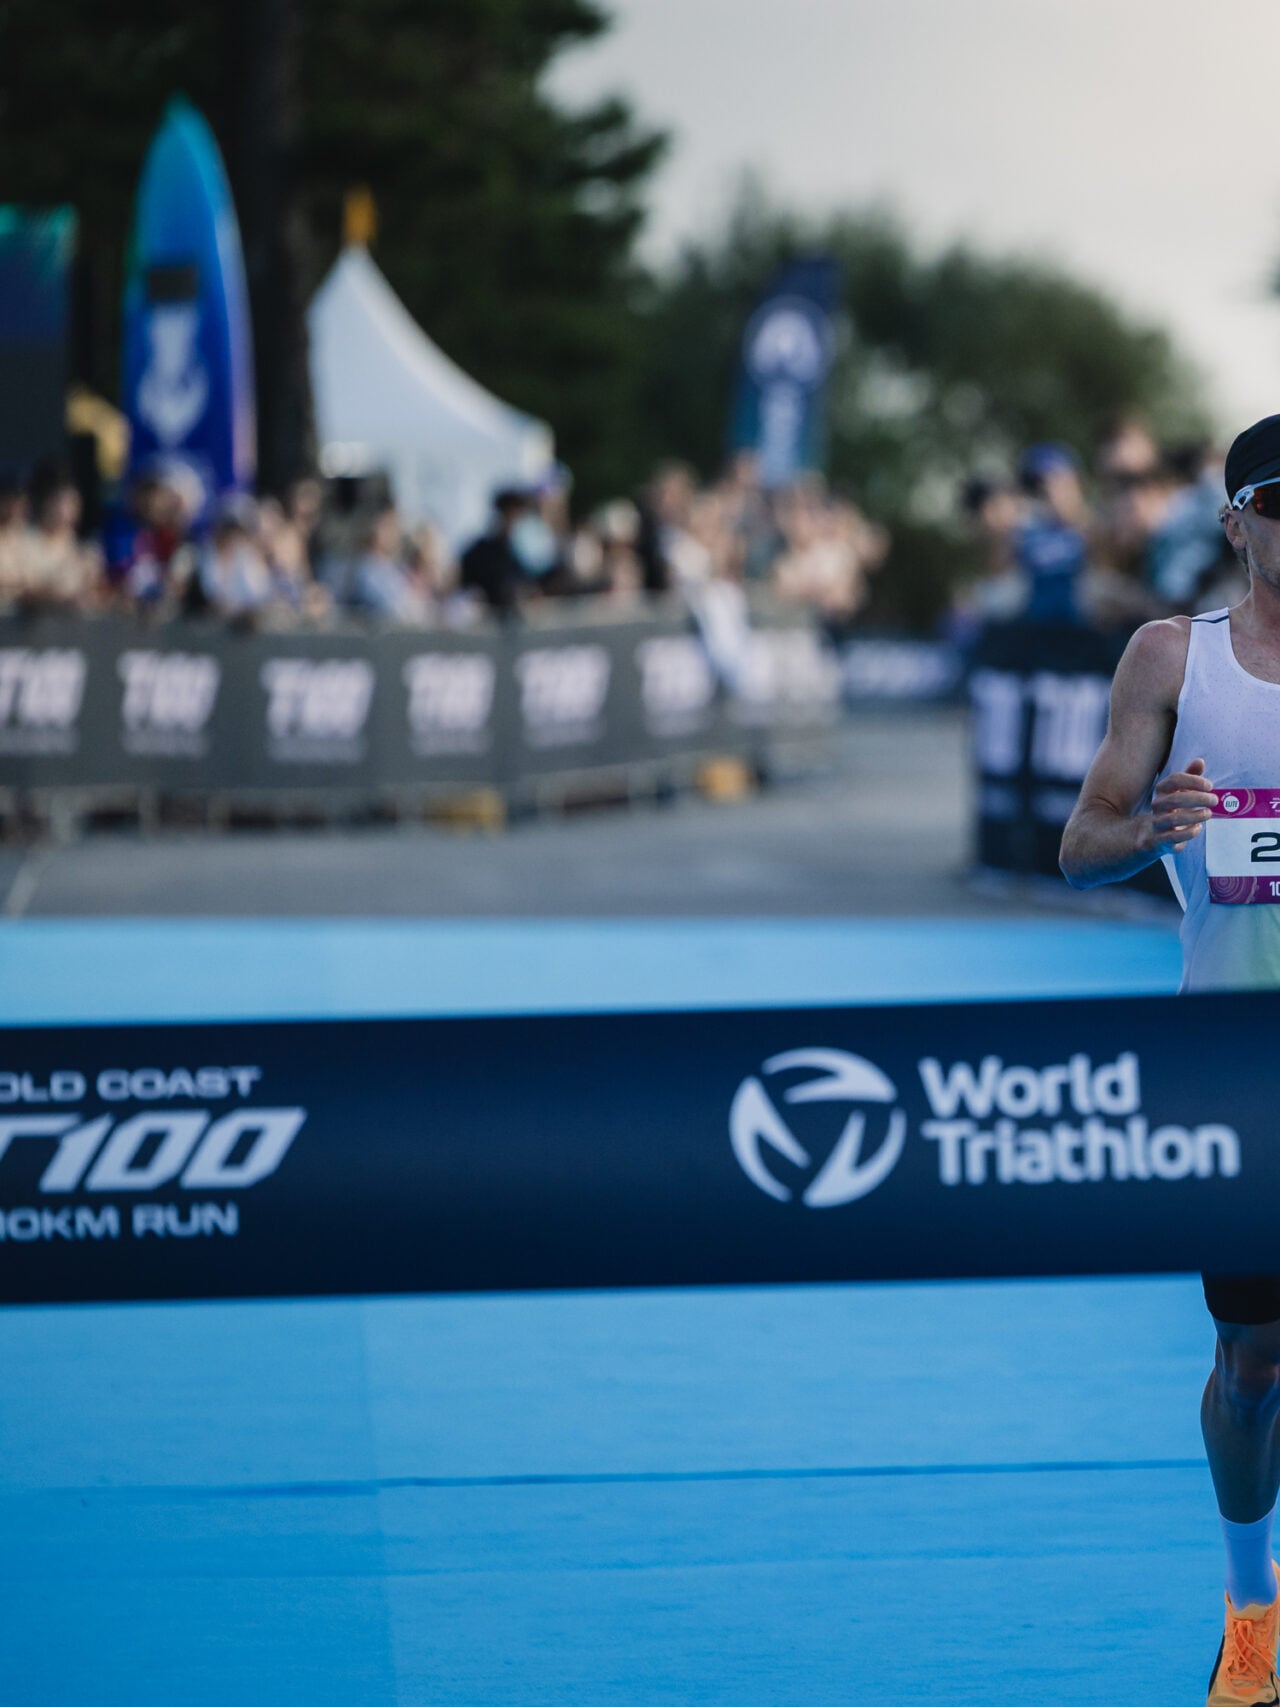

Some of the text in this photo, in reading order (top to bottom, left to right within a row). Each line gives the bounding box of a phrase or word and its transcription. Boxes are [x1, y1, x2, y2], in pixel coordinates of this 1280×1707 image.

[1225, 800, 1238, 808] ELITE
[97, 1065, 262, 1100] COAST
[918, 1052, 1141, 1118] World
[921, 1116, 1240, 1185] Triathlon
[132, 1202, 239, 1236] RUN
